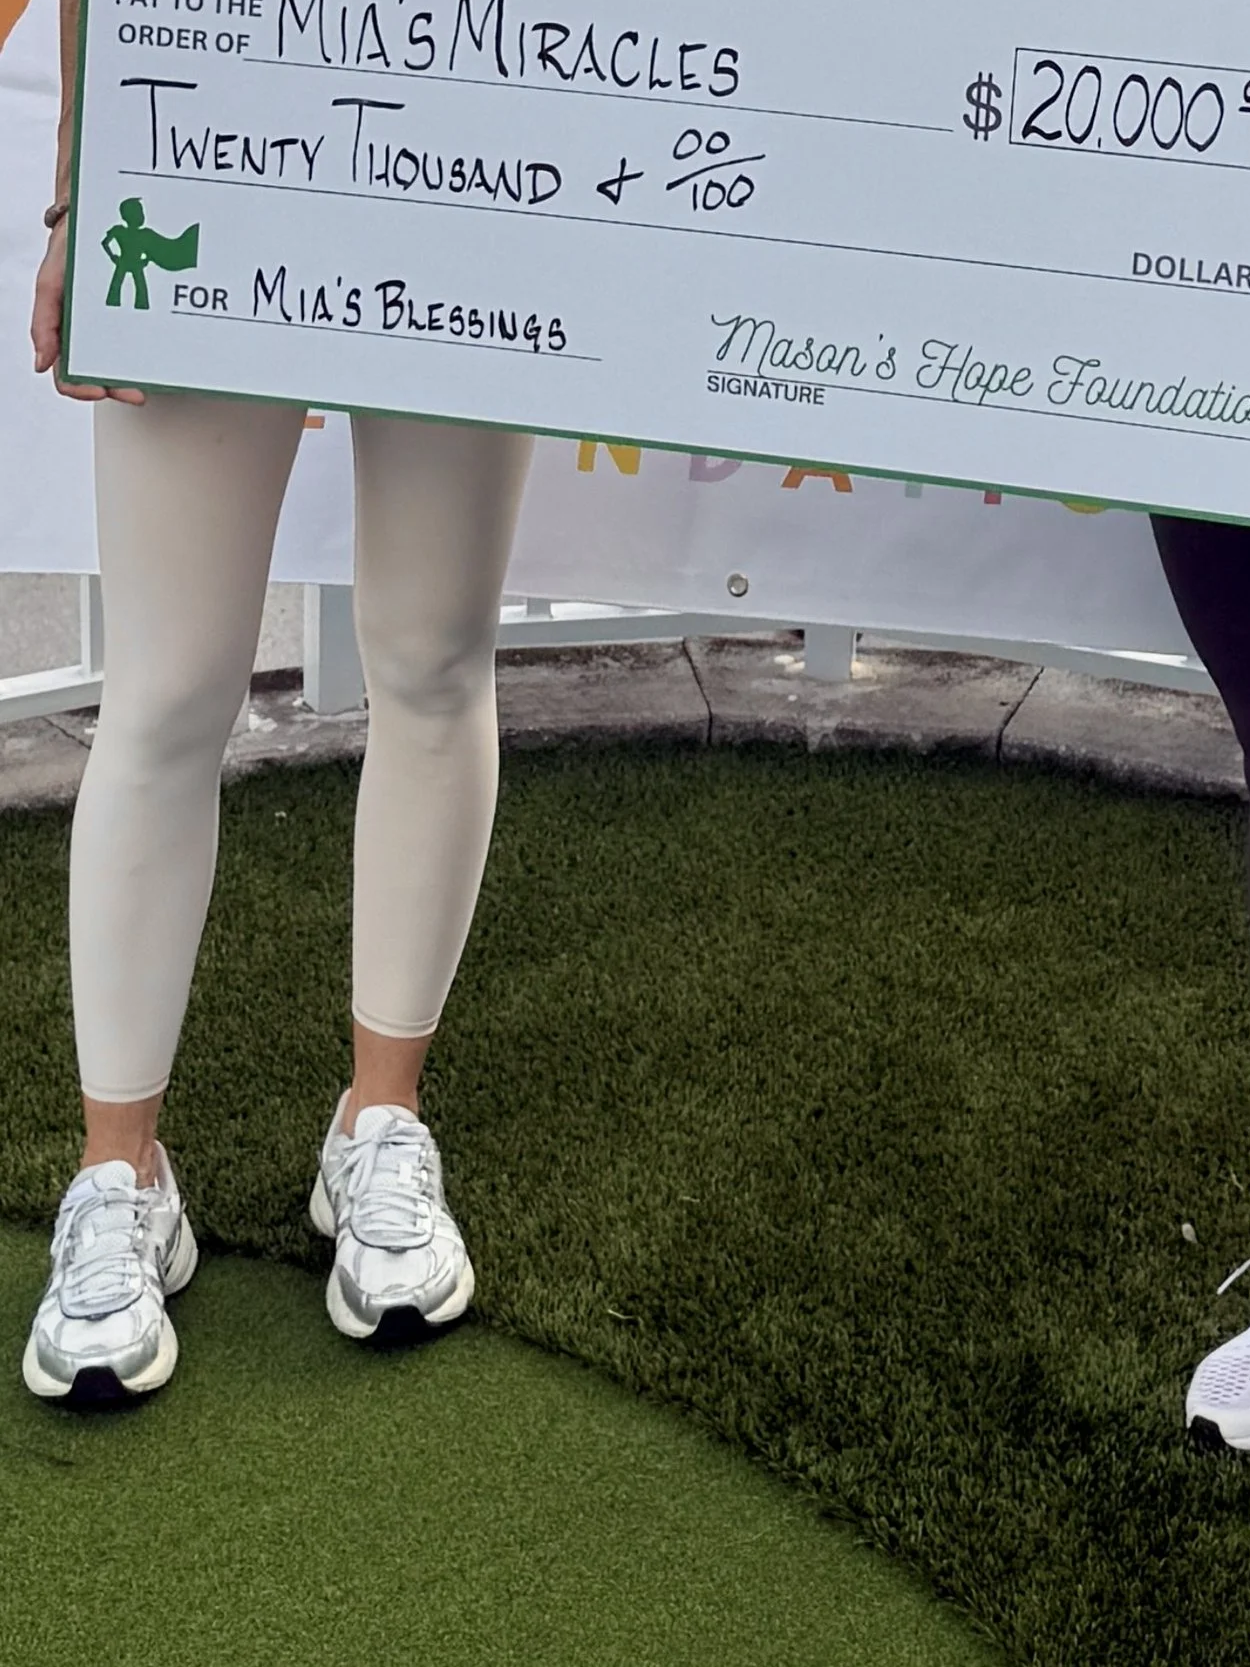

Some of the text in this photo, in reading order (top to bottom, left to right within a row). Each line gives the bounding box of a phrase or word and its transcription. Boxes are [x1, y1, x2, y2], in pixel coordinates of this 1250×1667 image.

[118, 23, 251, 55] ORDER OF
[963, 70, 1003, 142] $
[332, 98, 563, 206] THOUSAND
[173, 284, 229, 312] FOR
[253, 266, 567, 352] MIA'S BLESSINGS
[706, 374, 826, 406] SIGNATURE
[711, 314, 897, 381] Mason's
[915, 339, 1034, 406] Hope
